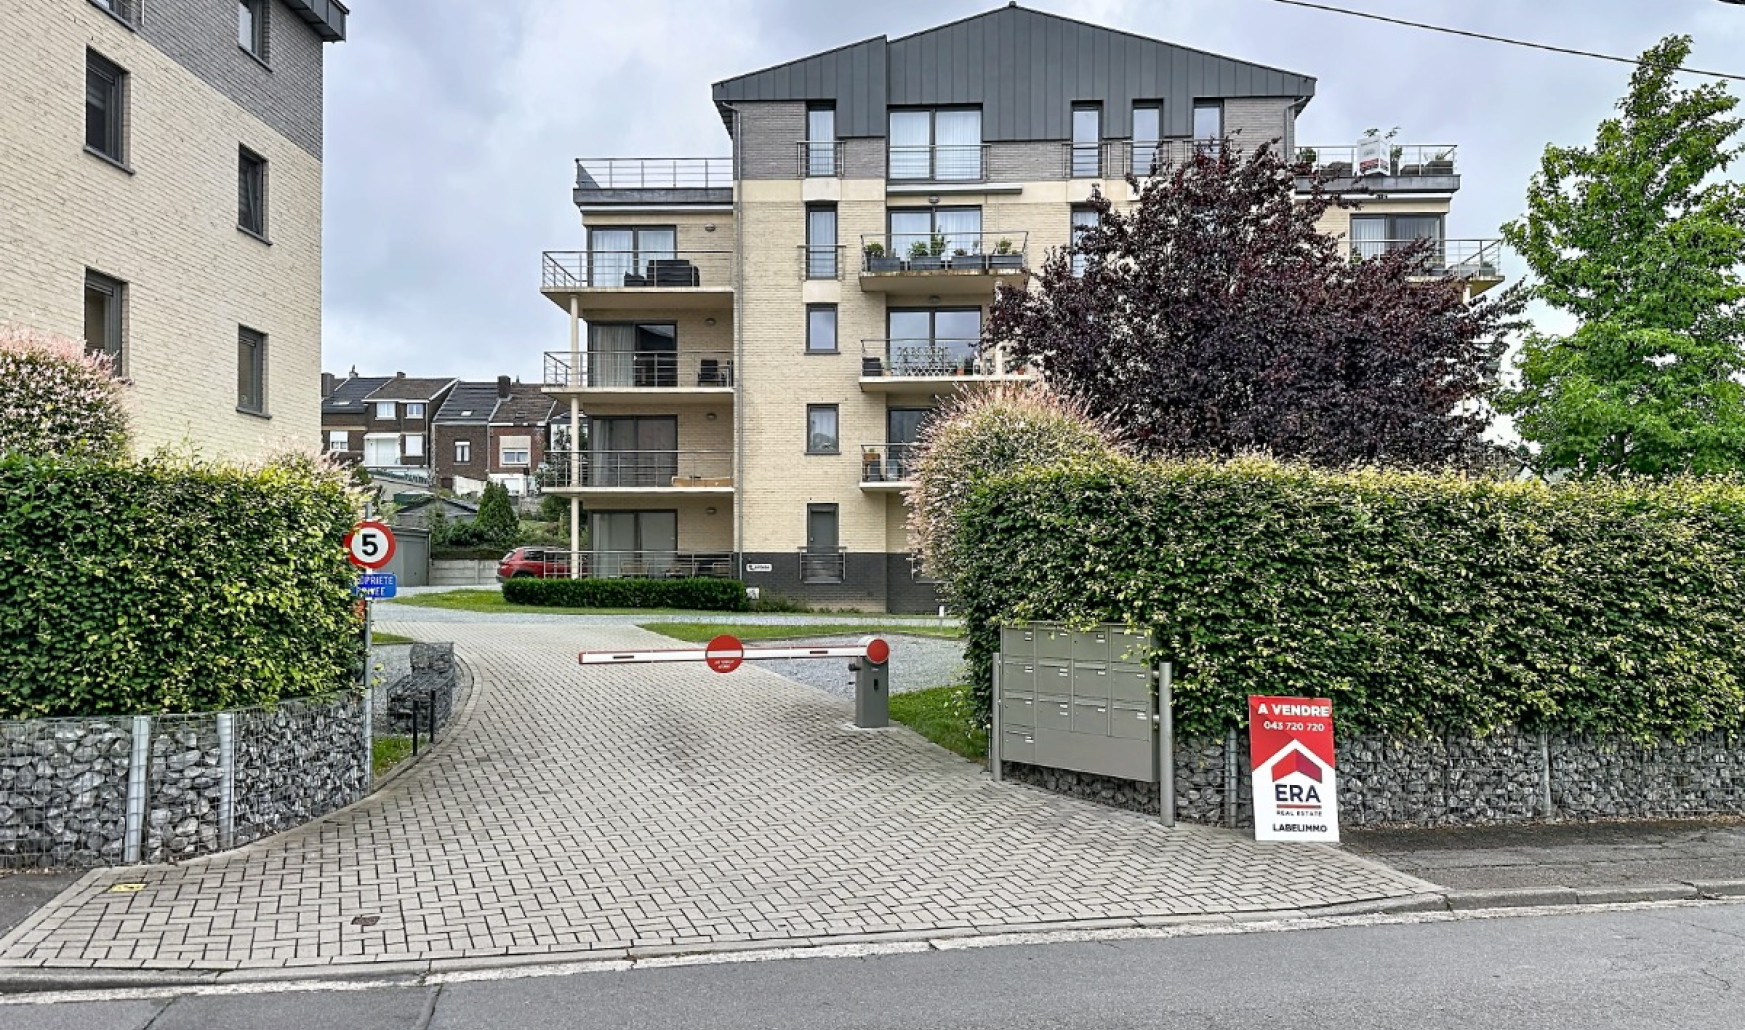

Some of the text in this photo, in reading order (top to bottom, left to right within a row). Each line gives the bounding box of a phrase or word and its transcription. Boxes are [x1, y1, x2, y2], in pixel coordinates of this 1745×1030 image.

[362, 534, 378, 556] 5
[1258, 703, 1330, 717] A VENDRE
[1285, 722, 1303, 731] 720
[1306, 723, 1325, 732] 720
[1275, 784, 1321, 802] ERA
[1272, 823, 1327, 833] LABELIMMO
